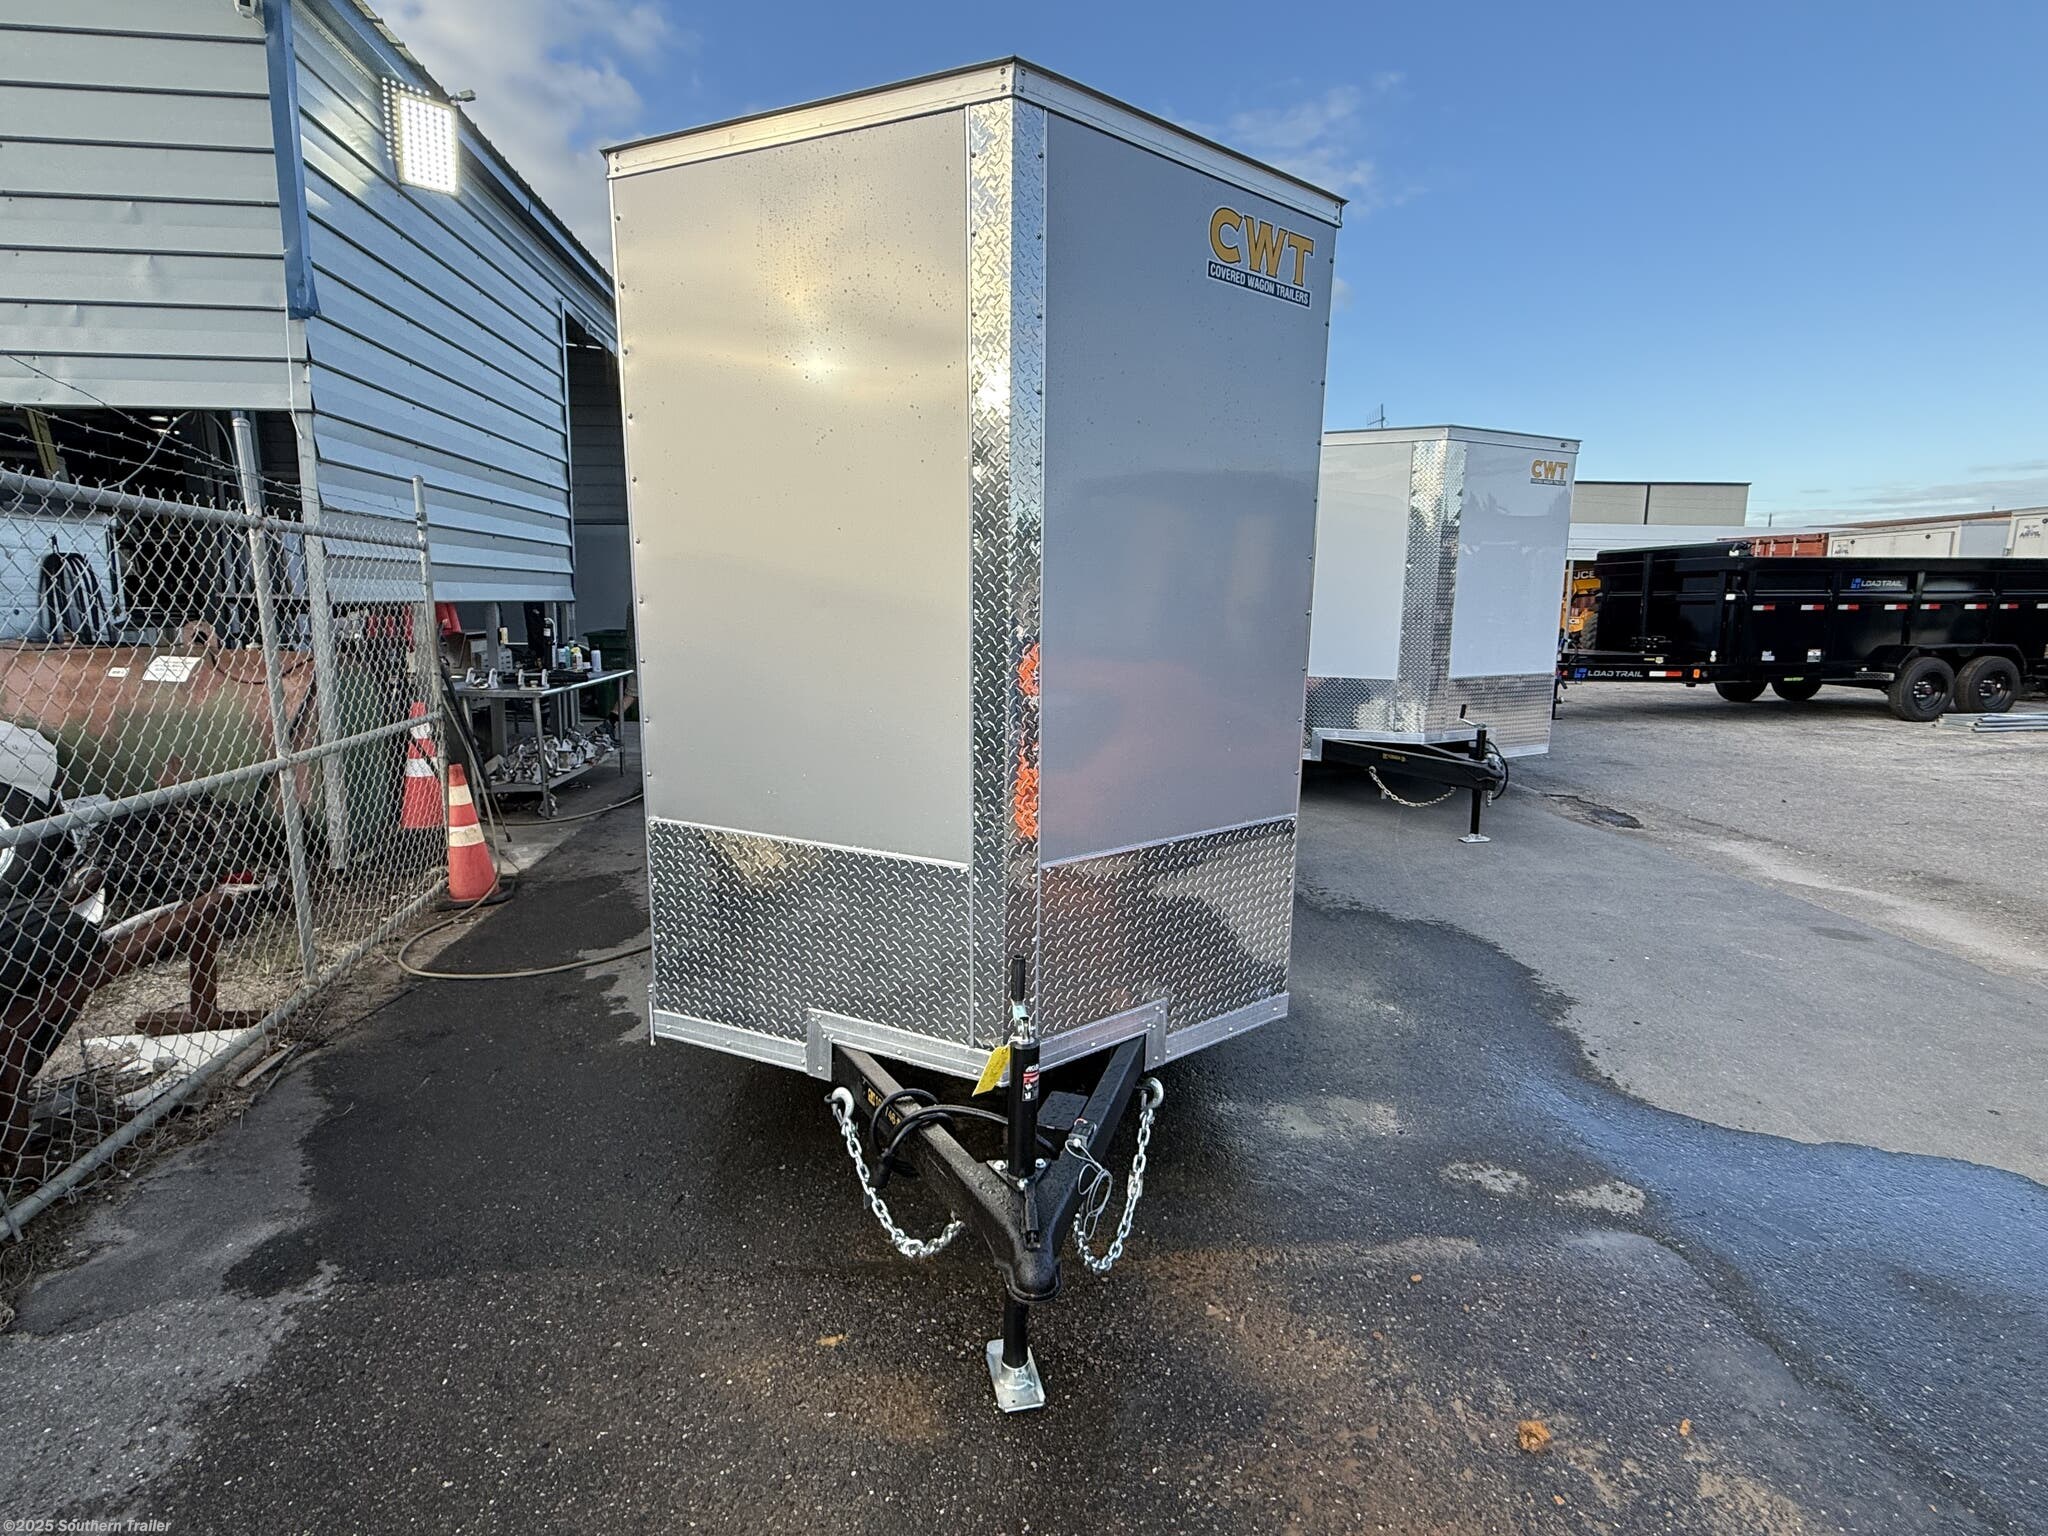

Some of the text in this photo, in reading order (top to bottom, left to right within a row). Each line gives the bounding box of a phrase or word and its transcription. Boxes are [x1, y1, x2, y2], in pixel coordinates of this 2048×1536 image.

[1210, 207, 1314, 287] CWT
[1209, 263, 1309, 305] COVERED WAGON TRAILERS
[1531, 460, 1568, 480] CWT
